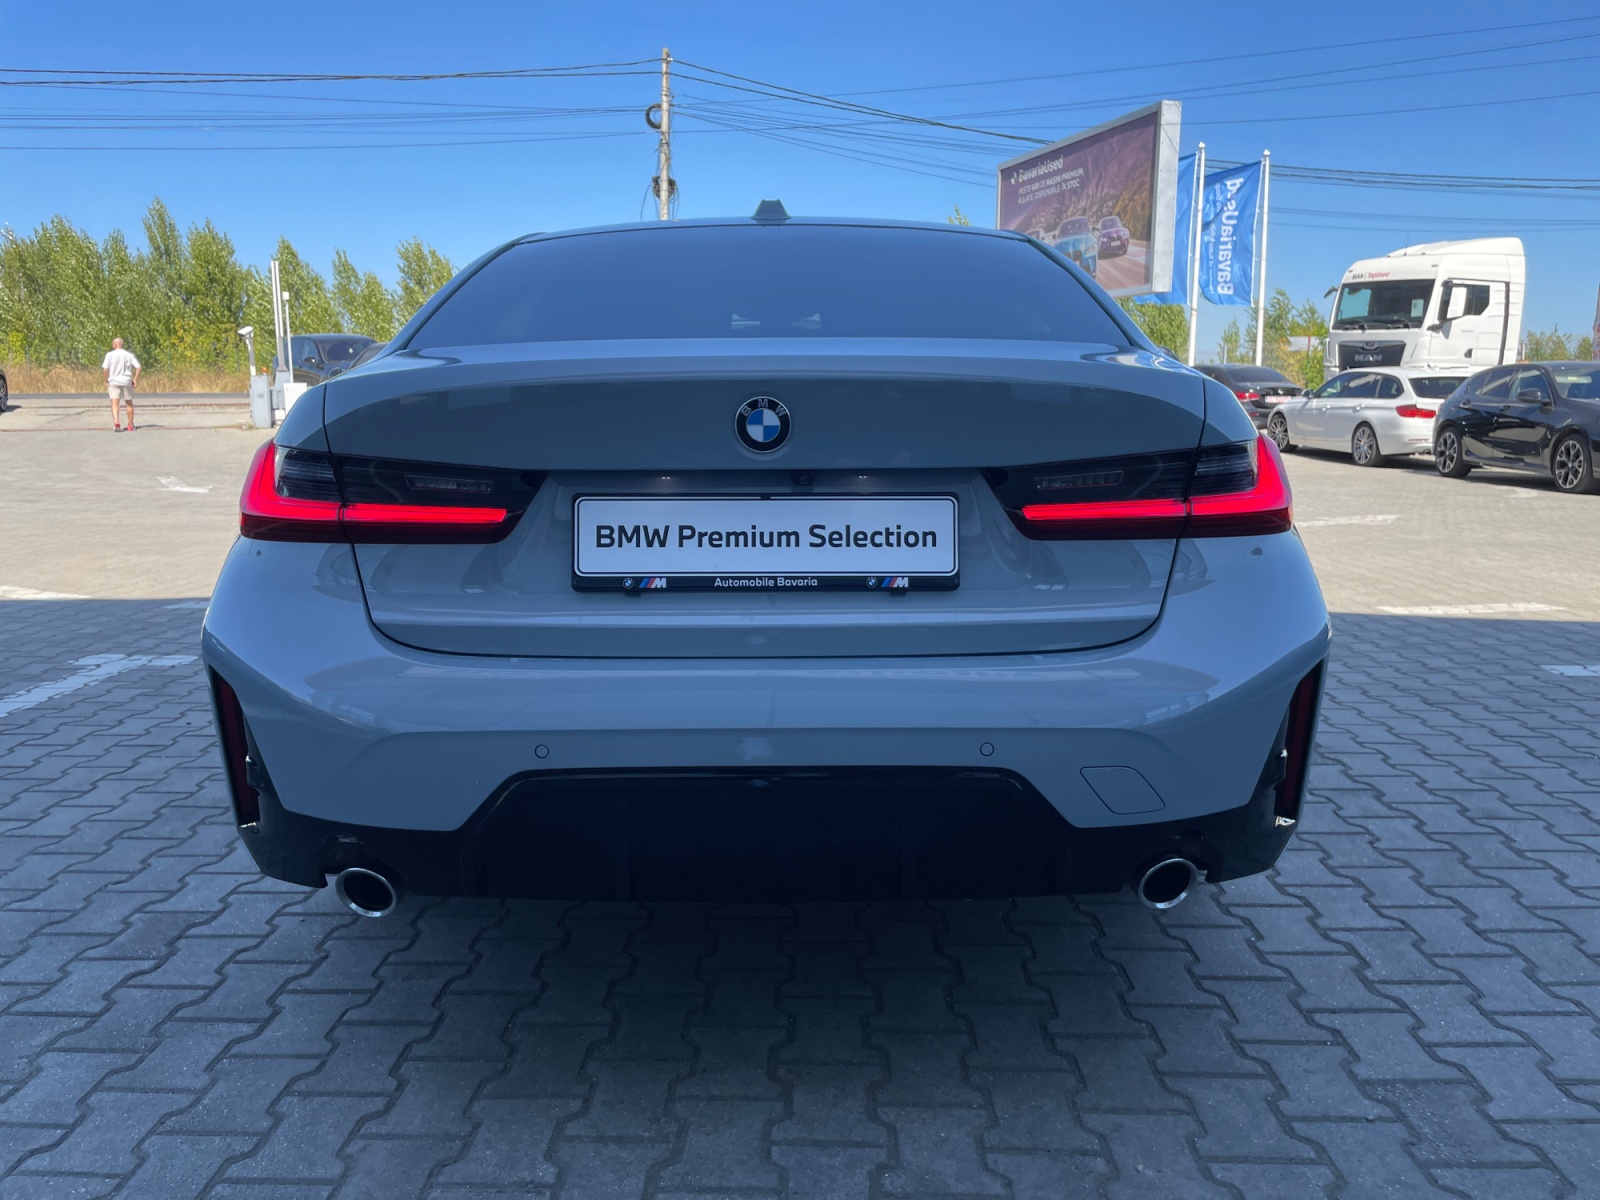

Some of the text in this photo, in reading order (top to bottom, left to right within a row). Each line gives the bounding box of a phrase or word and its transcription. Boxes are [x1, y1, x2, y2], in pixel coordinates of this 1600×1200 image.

[1018, 154, 1064, 182] BavariaUsed
[1354, 353, 1383, 362] MAN
[740, 398, 787, 417] BMW
[596, 524, 937, 548] BMW Premium Selection
[714, 577, 818, 587] Automobile Bavaria
